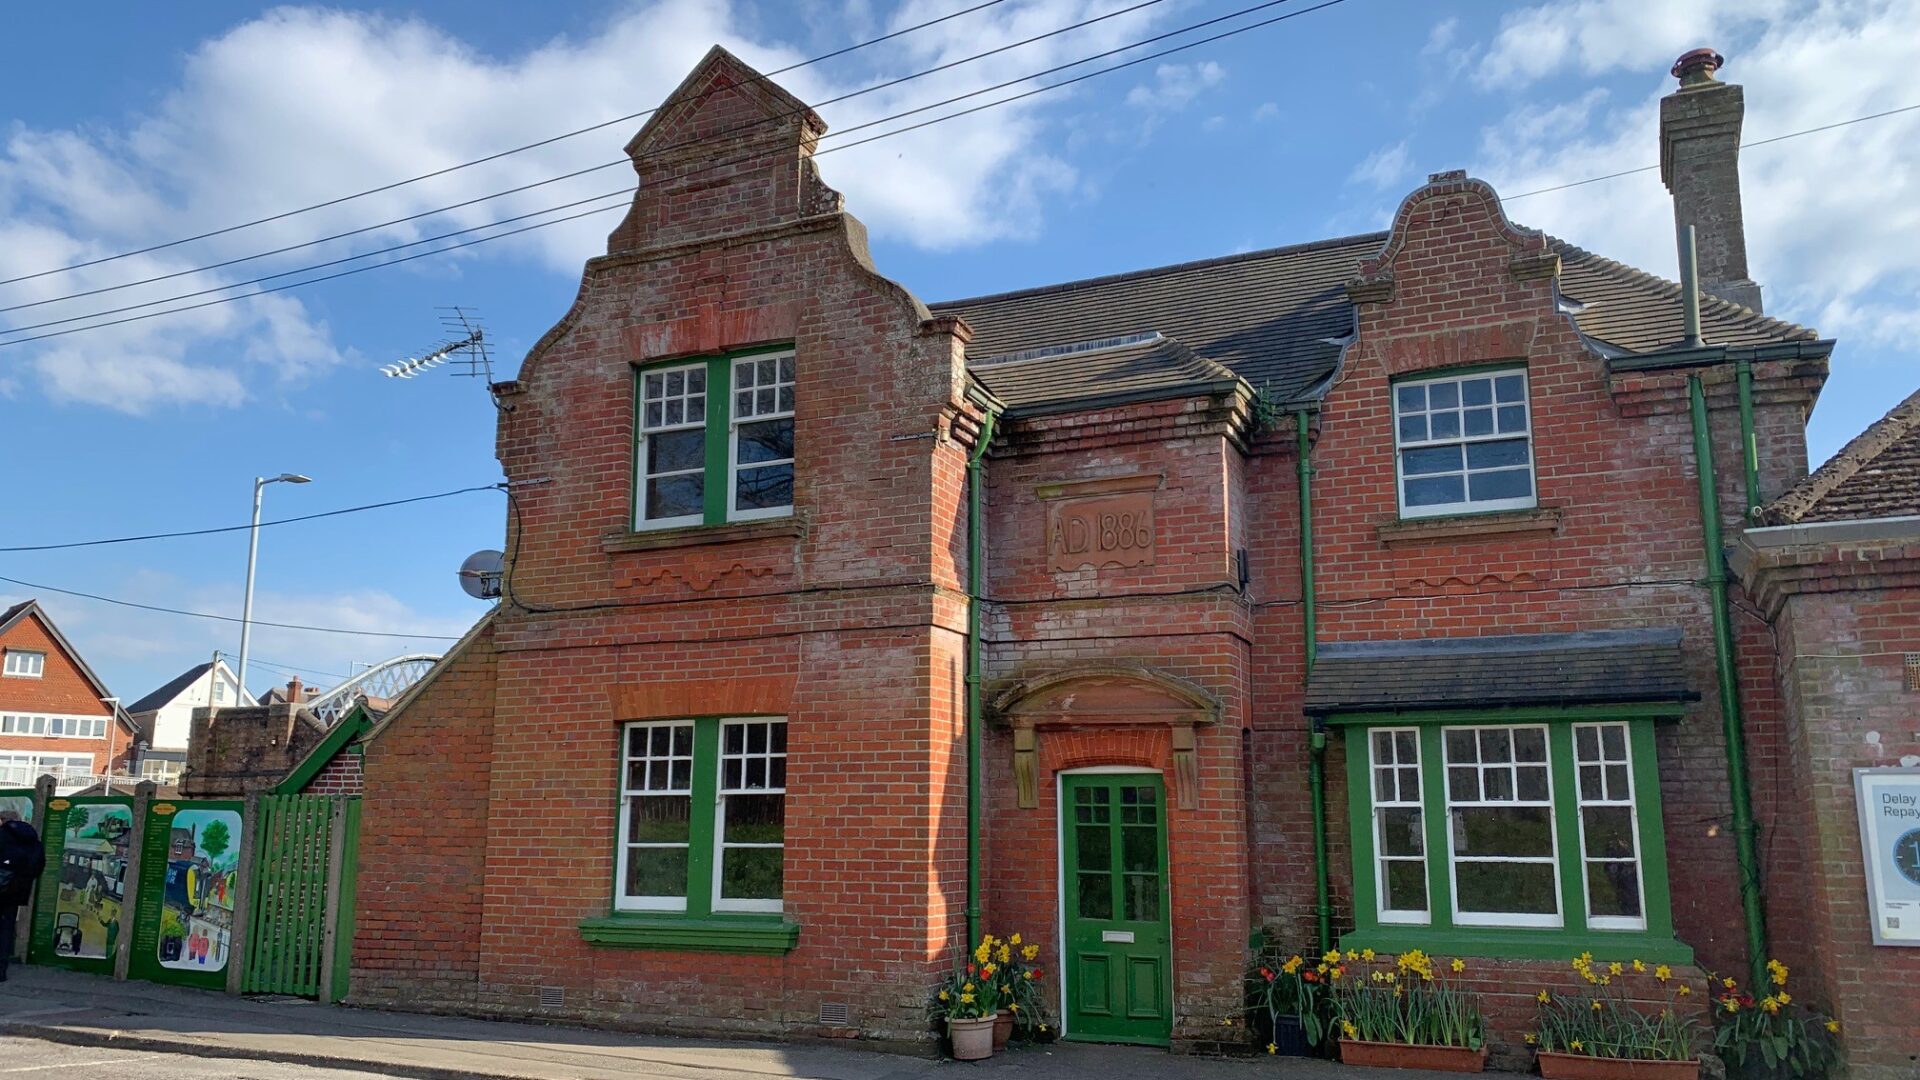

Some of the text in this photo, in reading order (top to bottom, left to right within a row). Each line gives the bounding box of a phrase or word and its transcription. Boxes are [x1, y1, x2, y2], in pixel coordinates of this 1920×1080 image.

[1097, 511, 1152, 552] 1886
[1882, 793, 1917, 807] Delay
[1884, 806, 1920, 819] Repay
